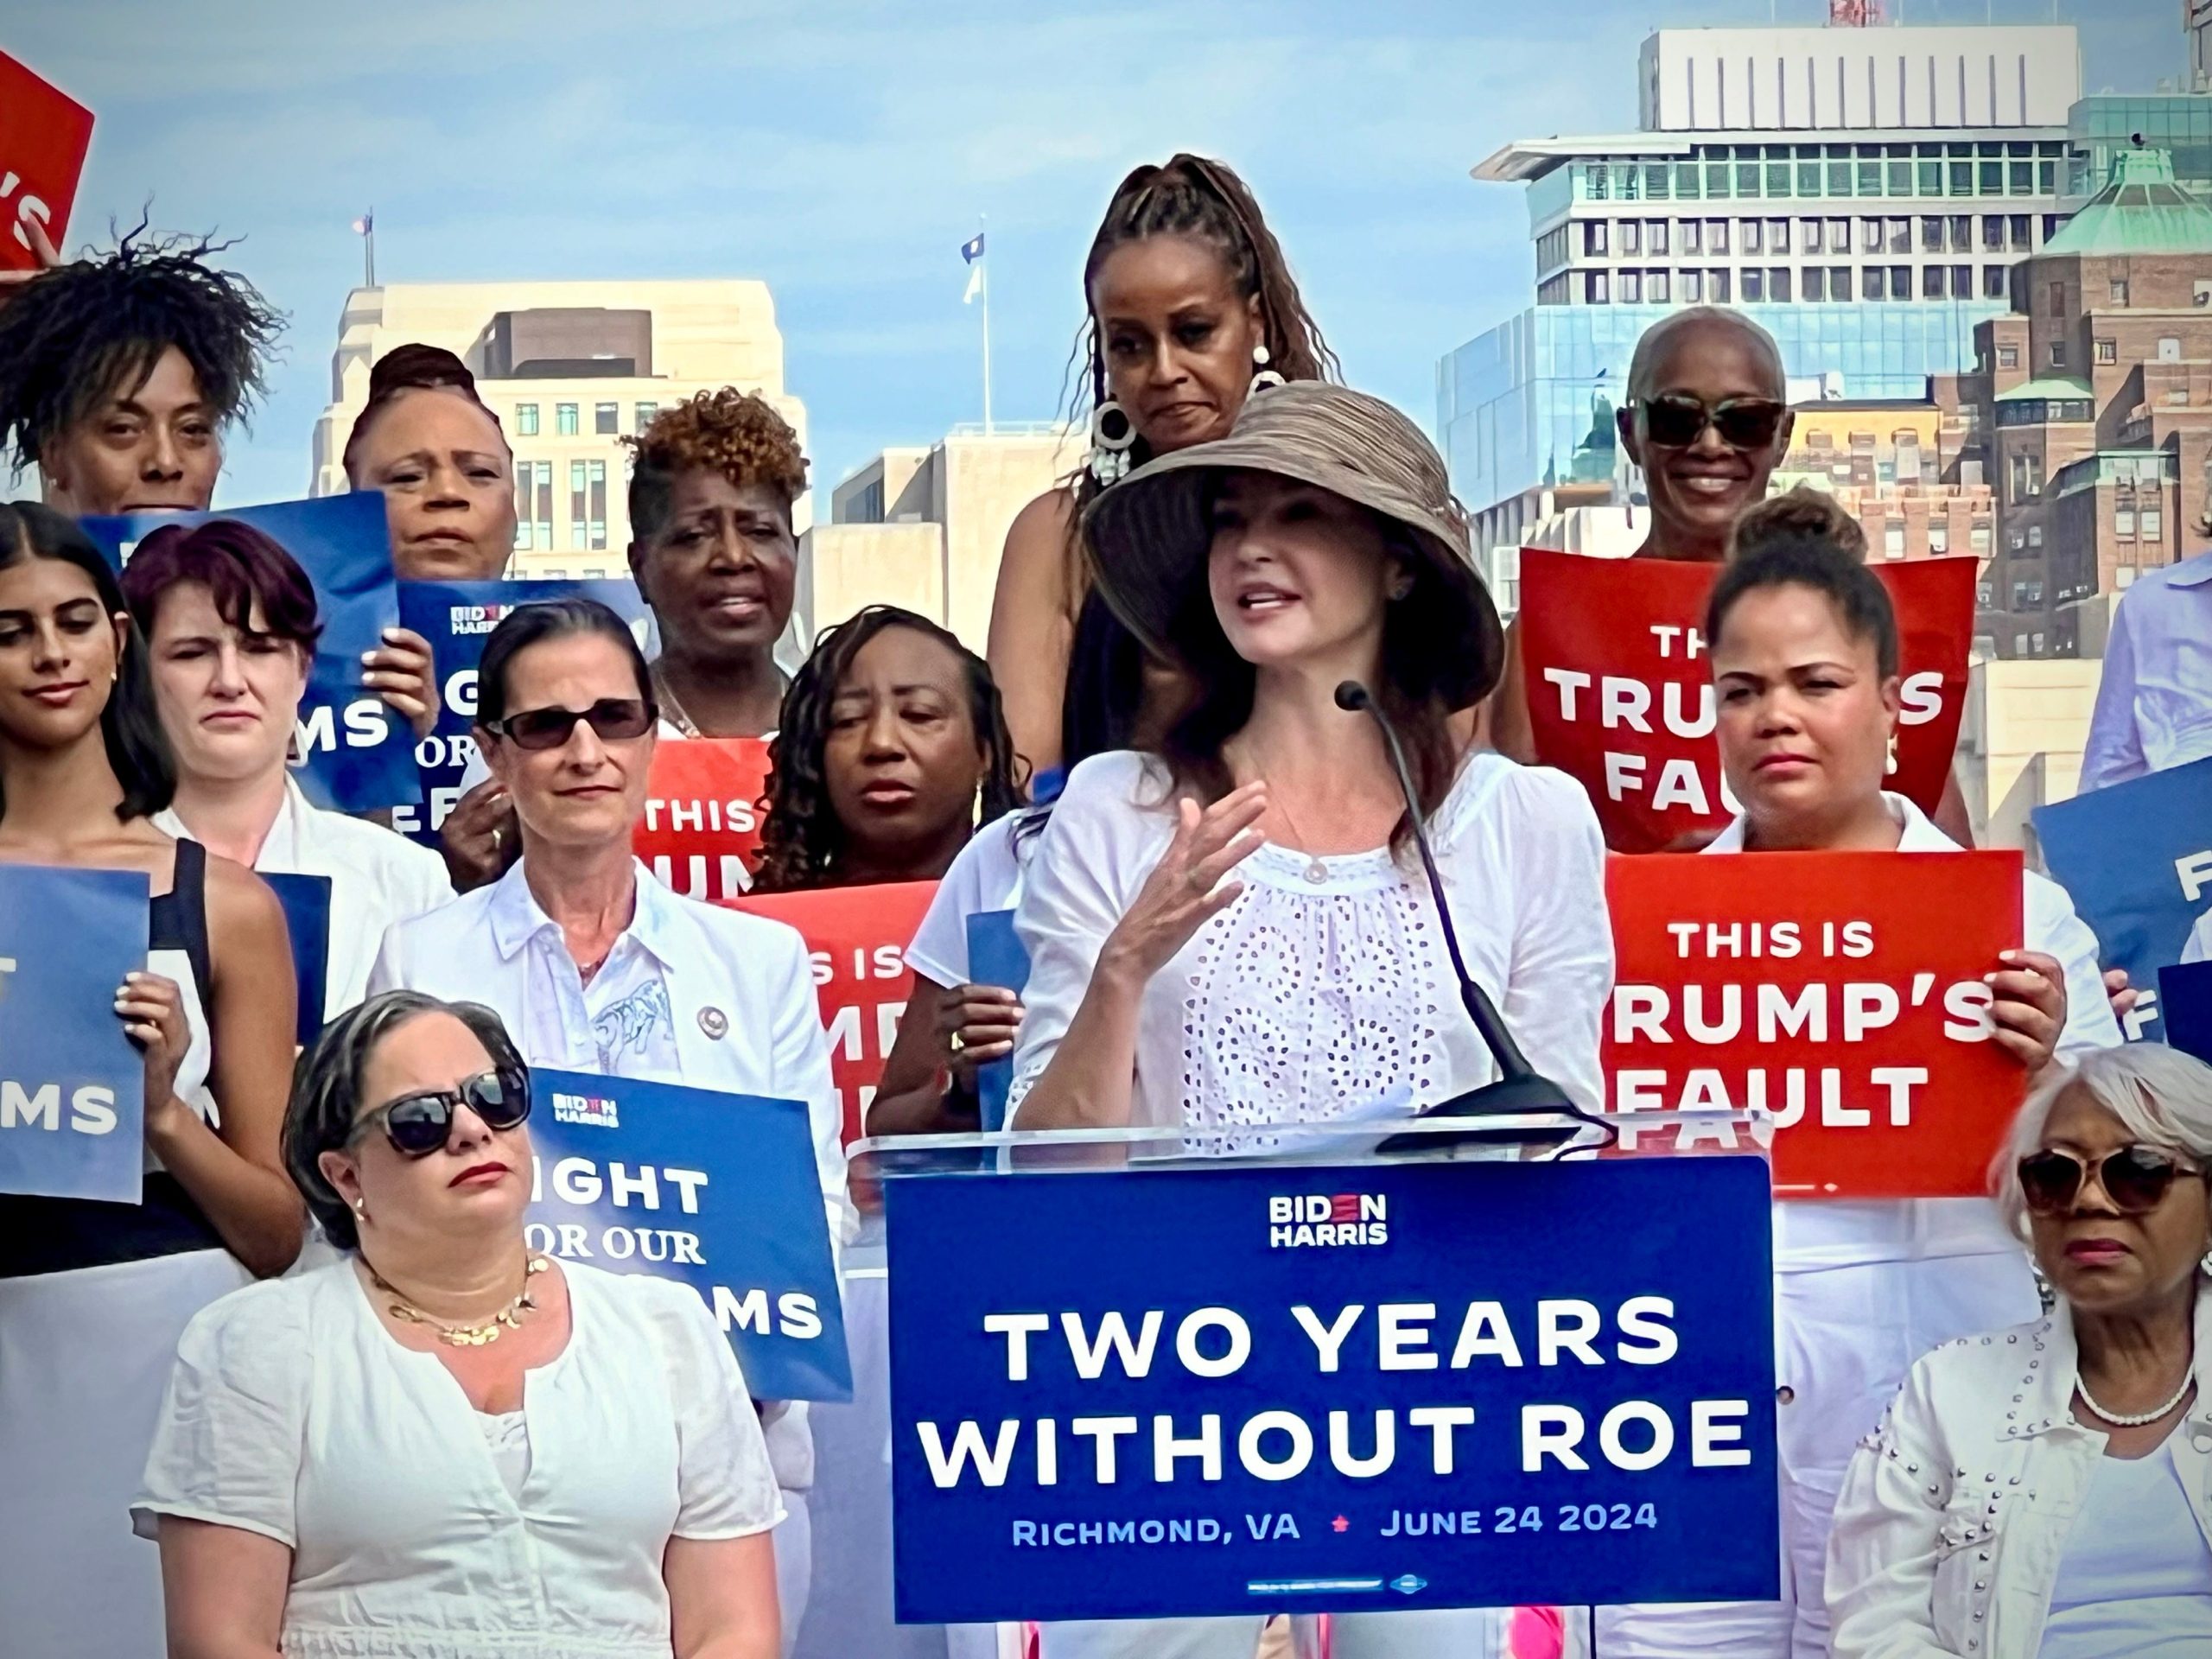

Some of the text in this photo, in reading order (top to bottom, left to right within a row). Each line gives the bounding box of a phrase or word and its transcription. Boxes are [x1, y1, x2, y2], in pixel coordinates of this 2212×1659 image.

[1649, 626, 1707, 659] TH
[645, 799, 755, 832] THIS
[1667, 921, 1875, 958] THIS IS
[1614, 973, 1993, 1044] RUMP'S
[1617, 1068, 1929, 1150] FAULT
[531, 1156, 709, 1214] IGHT
[1269, 1194, 1386, 1224] BIDEN
[524, 1224, 707, 1265] OR OUR
[1270, 1224, 1388, 1247] HARRIS
[984, 1296, 1678, 1381] TWO YEARS
[916, 1400, 1751, 1488] WITHOUT ROE
[1013, 1503, 1657, 1547] RICHMOND, VA JUNE 24 2024
